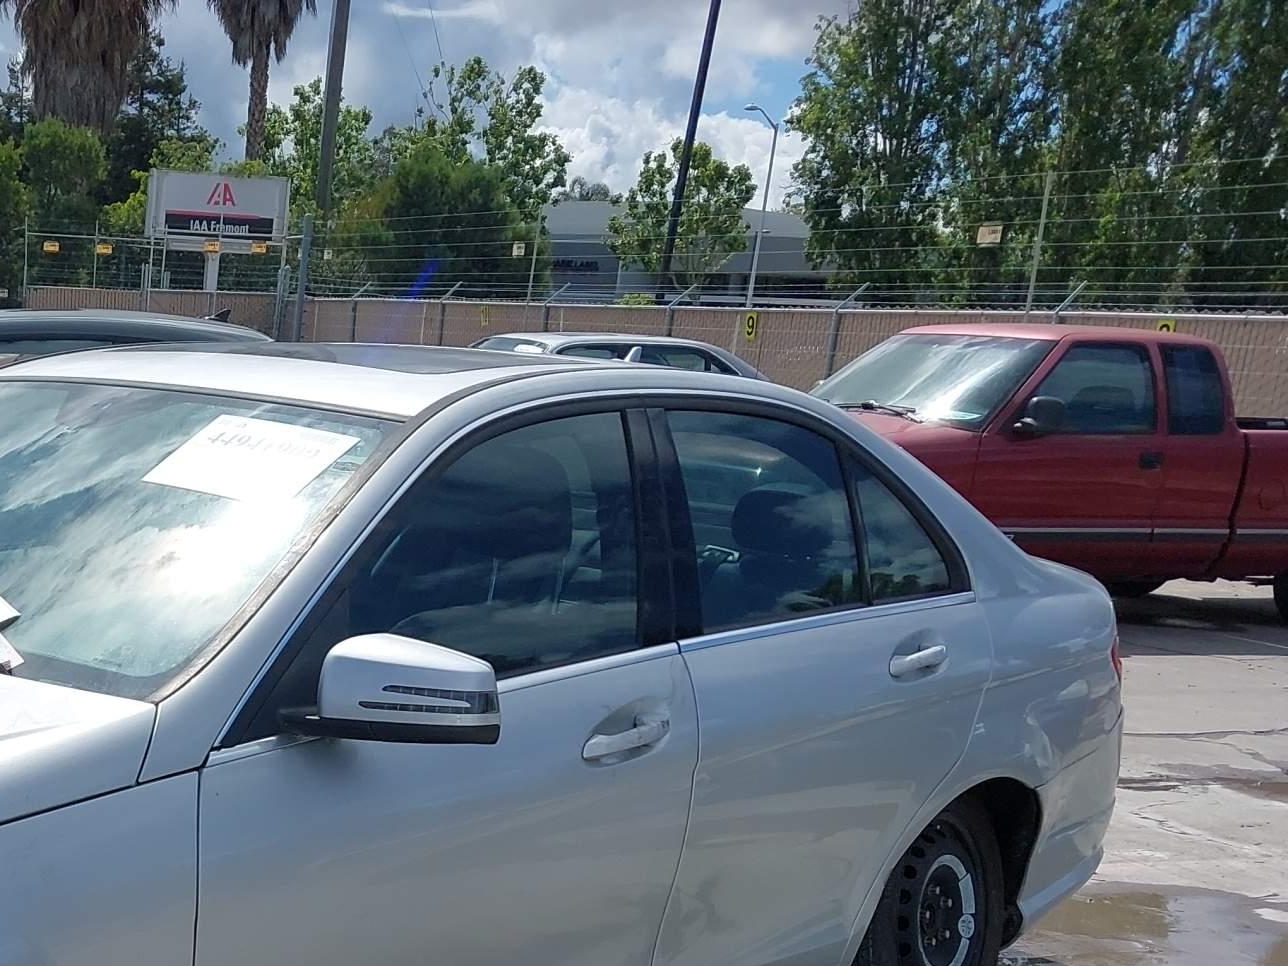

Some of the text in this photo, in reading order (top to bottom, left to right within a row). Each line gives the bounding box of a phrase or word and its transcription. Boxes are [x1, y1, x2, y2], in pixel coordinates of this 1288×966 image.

[190, 219, 249, 234] IAA Fremont
[746, 315, 755, 336] 9
